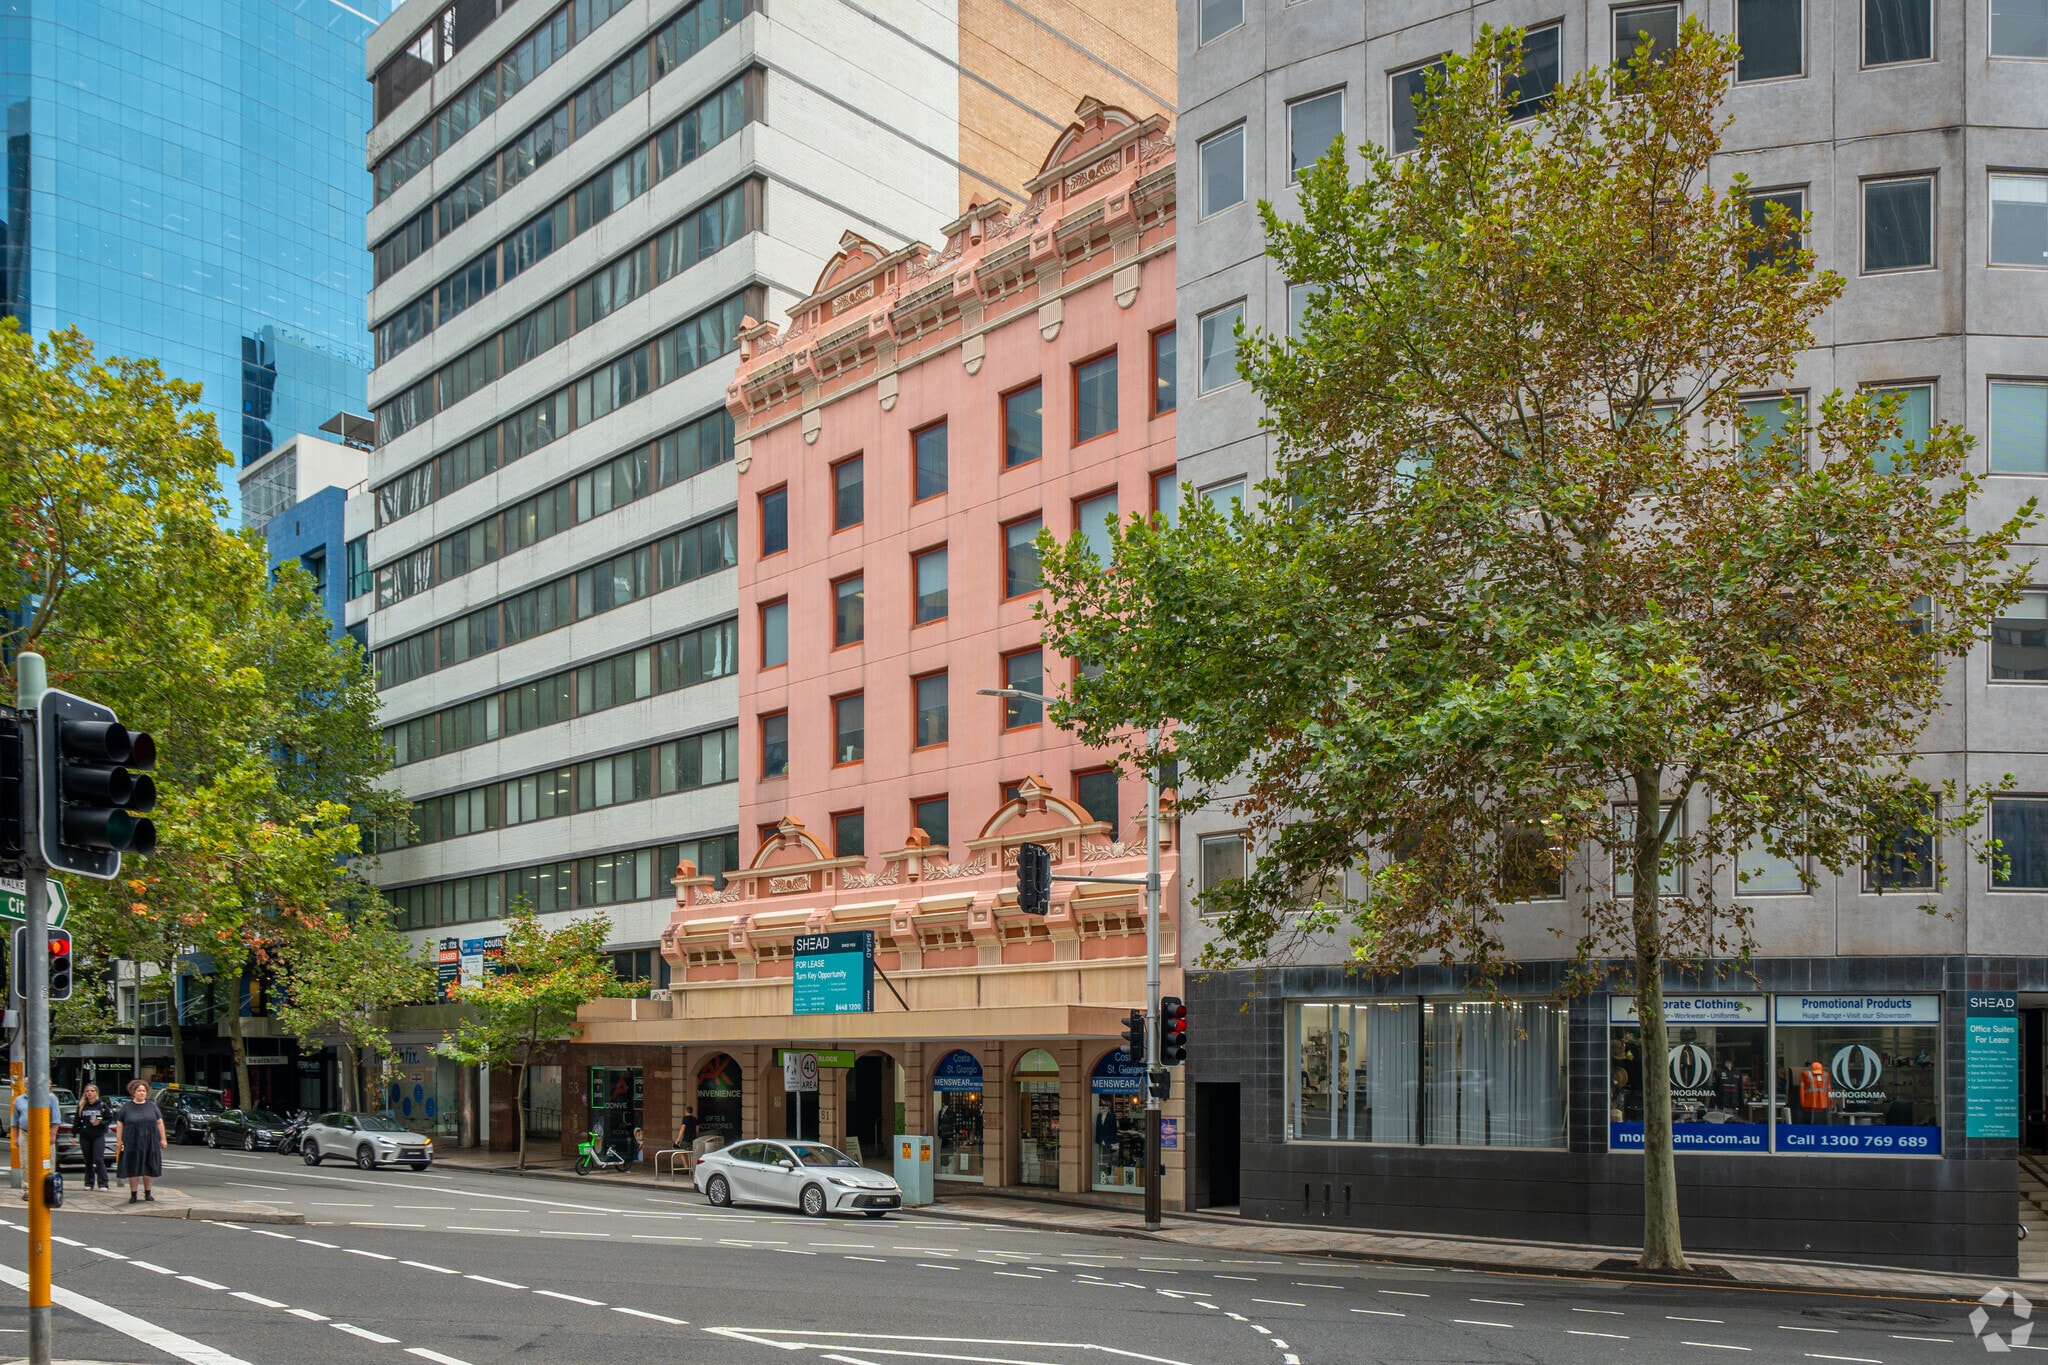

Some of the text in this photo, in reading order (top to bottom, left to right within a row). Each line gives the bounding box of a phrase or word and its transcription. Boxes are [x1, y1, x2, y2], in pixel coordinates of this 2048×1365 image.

[1, 879, 25, 891] WALKE
[8, 896, 25, 914] Cit
[439, 941, 457, 950] cotts
[796, 936, 830, 951] SHEAD
[796, 959, 825, 969] FOR LEASE
[796, 969, 847, 981] Turn Key Opportunity
[1663, 999, 1740, 1011] orate Clothing
[1802, 998, 1912, 1009] Promotional Products
[1970, 997, 2015, 1008] SHEAD
[1802, 1012, 1820, 1020] Huge
[1821, 1012, 1842, 1020] Range
[1969, 1024, 2015, 1033] Office Suites
[1975, 1036, 2010, 1044] For Lease
[953, 1054, 971, 1063] Costa
[803, 1060, 816, 1073] 40
[956, 1065, 978, 1076] Giorgio
[802, 1081, 817, 1089] AREA
[934, 1078, 970, 1086] MENSWEAR
[1092, 1079, 1135, 1088] MENSWEAR
[569, 1082, 579, 1094] 53
[1669, 1089, 1716, 1097] ONOGRAMA
[1828, 1090, 1887, 1099] MONOGRAMA
[821, 1110, 830, 1120] 51
[1786, 1134, 1928, 1147] Call 1300 769 689
